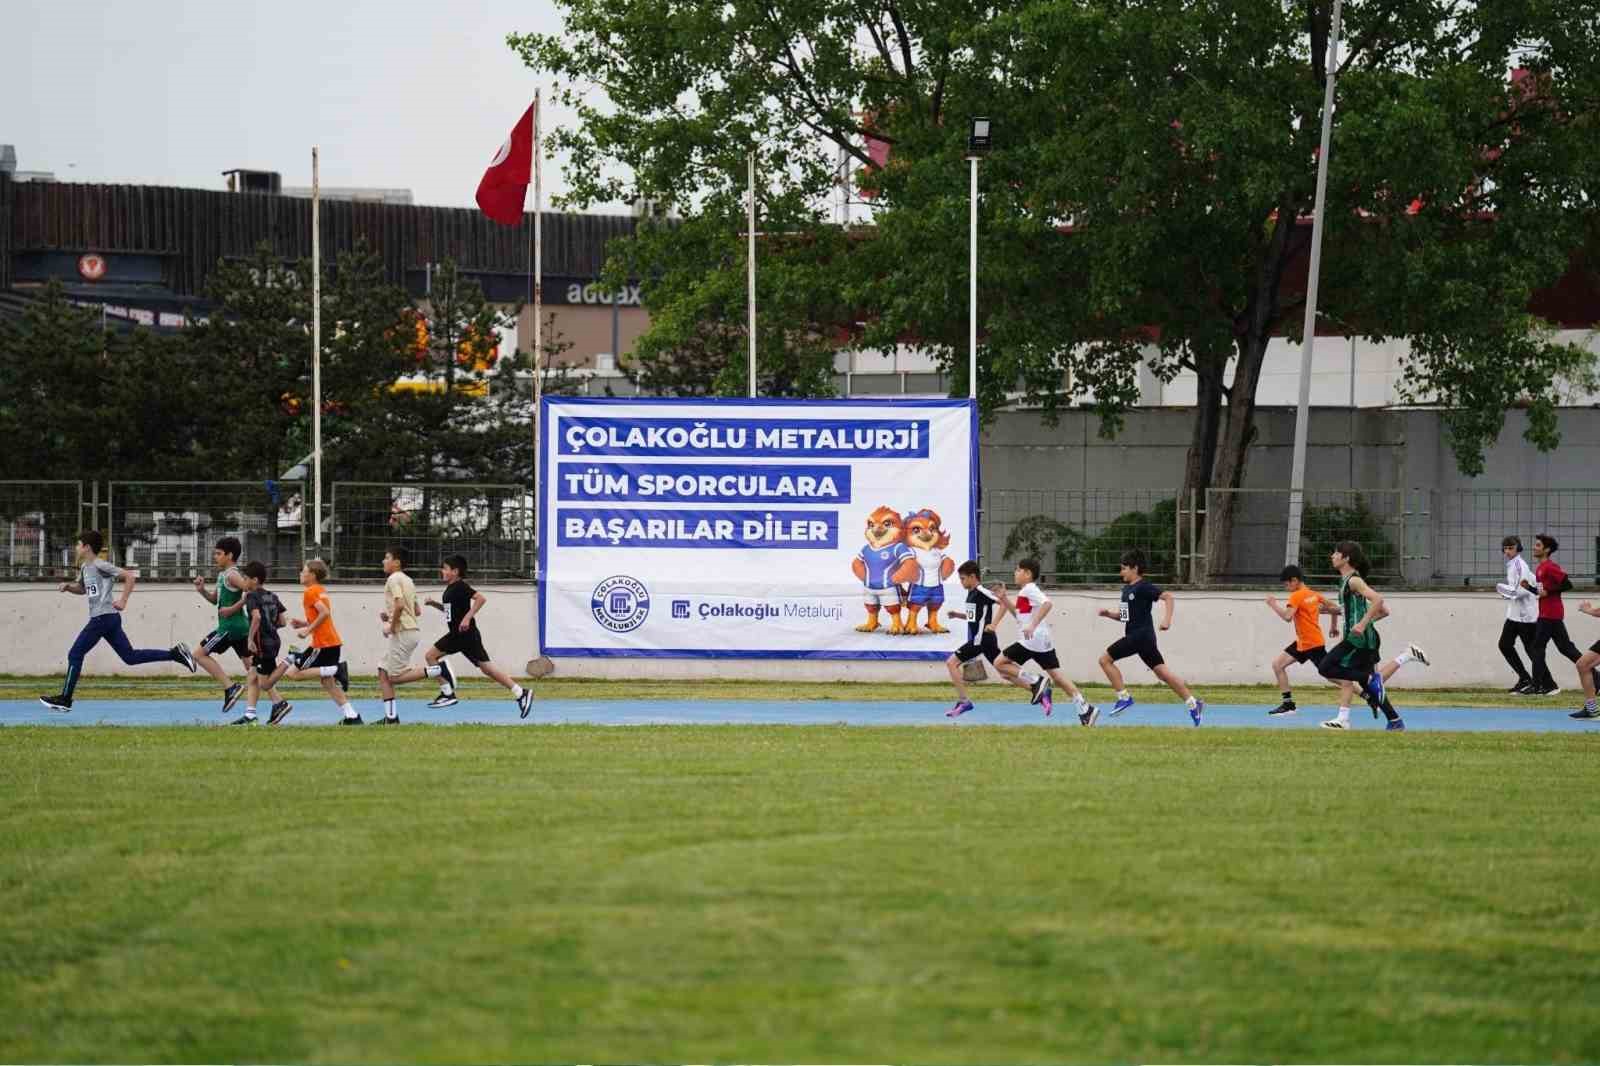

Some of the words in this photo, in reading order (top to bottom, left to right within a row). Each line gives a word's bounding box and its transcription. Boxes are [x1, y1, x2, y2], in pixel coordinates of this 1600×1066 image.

[566, 422, 747, 452] ÇOLAKOĞLU
[755, 422, 919, 450] METALURJİ
[564, 468, 629, 496] TÜM
[637, 474, 839, 498] SPORCULARA
[565, 518, 735, 545] BAŞARILAR
[742, 513, 829, 541] DİLER
[698, 602, 780, 621] Çolakoğlu
[783, 603, 843, 621] Metalurji
